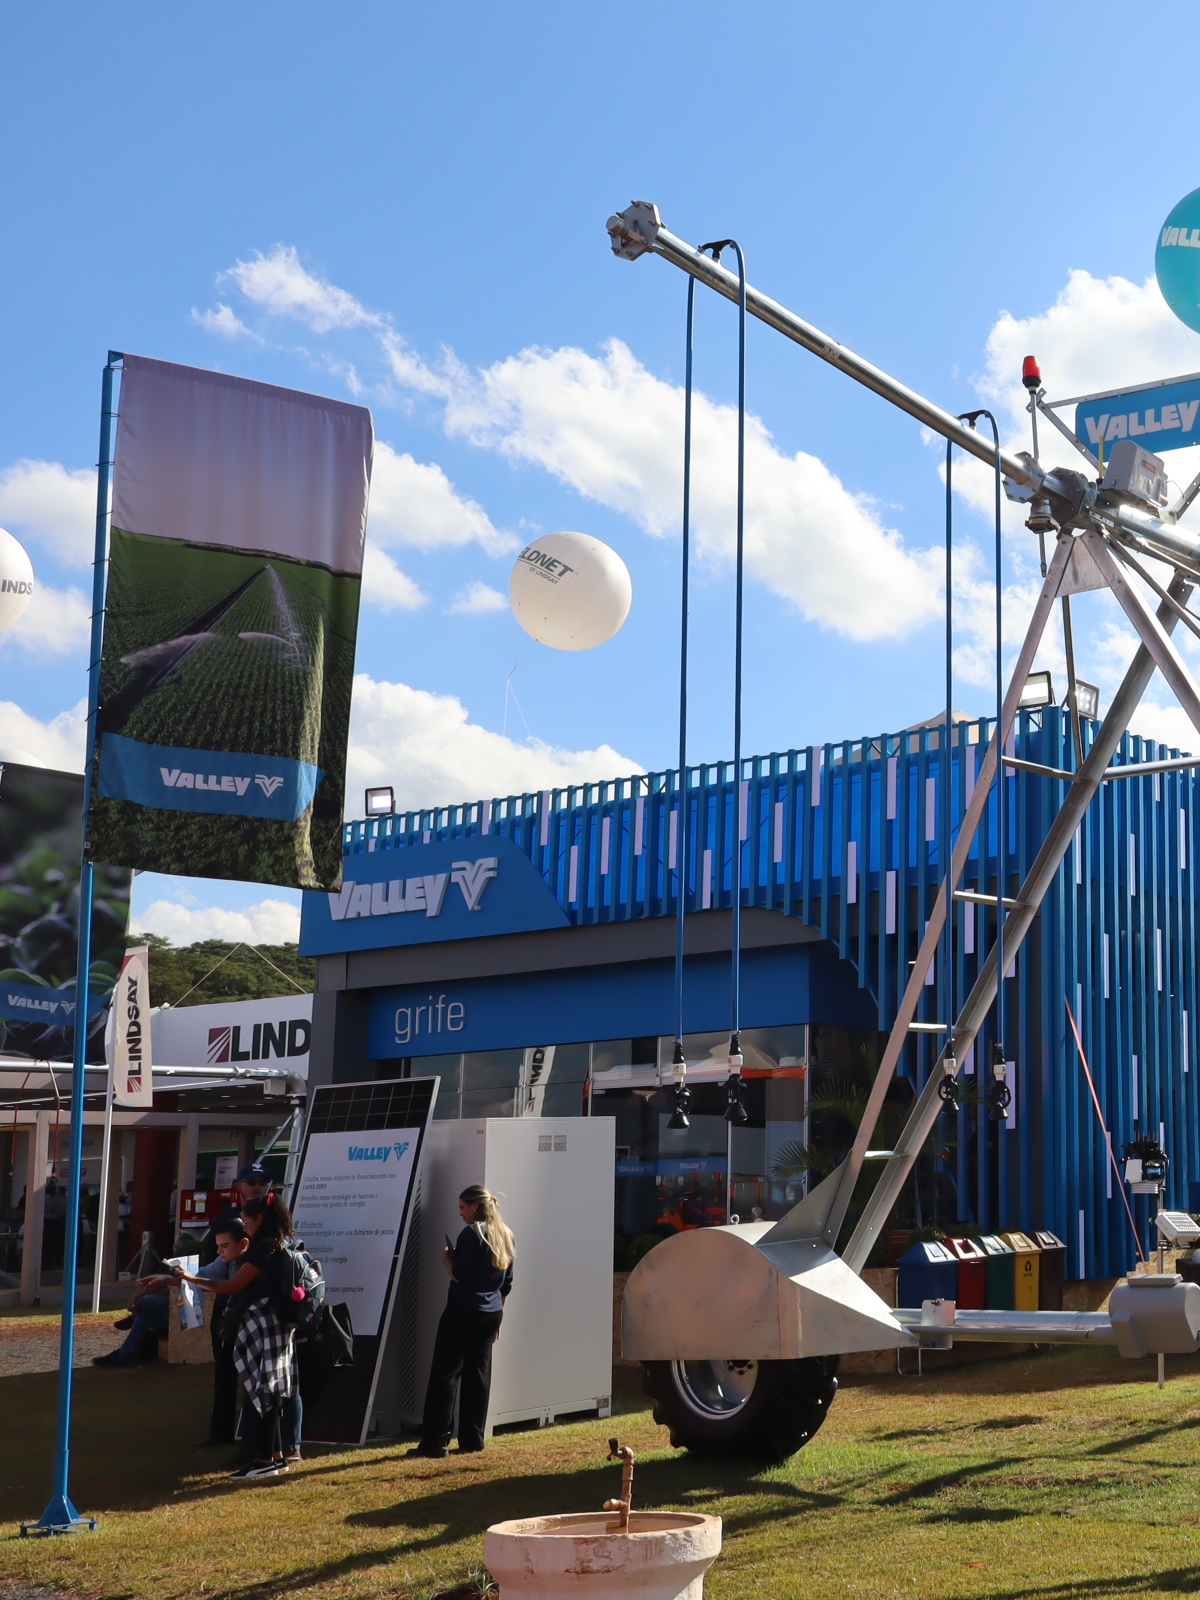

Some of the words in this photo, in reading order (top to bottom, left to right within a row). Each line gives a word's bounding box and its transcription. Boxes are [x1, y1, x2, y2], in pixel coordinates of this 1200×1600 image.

[1084, 399, 1200, 444] VALLEY
[535, 569, 559, 585] LINDSAY
[160, 767, 250, 796] VALLEY
[328, 872, 450, 921] VALLEY
[7, 993, 60, 1013] VALLEY
[126, 975, 142, 1075] LINDSAY
[394, 994, 466, 1044] grife
[348, 1146, 392, 1163] VALLEY
[299, 1220, 324, 1229] Eficiência
[314, 1228, 332, 1238] energia
[354, 1228, 374, 1236] horários
[380, 1228, 395, 1237] ponta
[330, 1256, 348, 1264] energia
